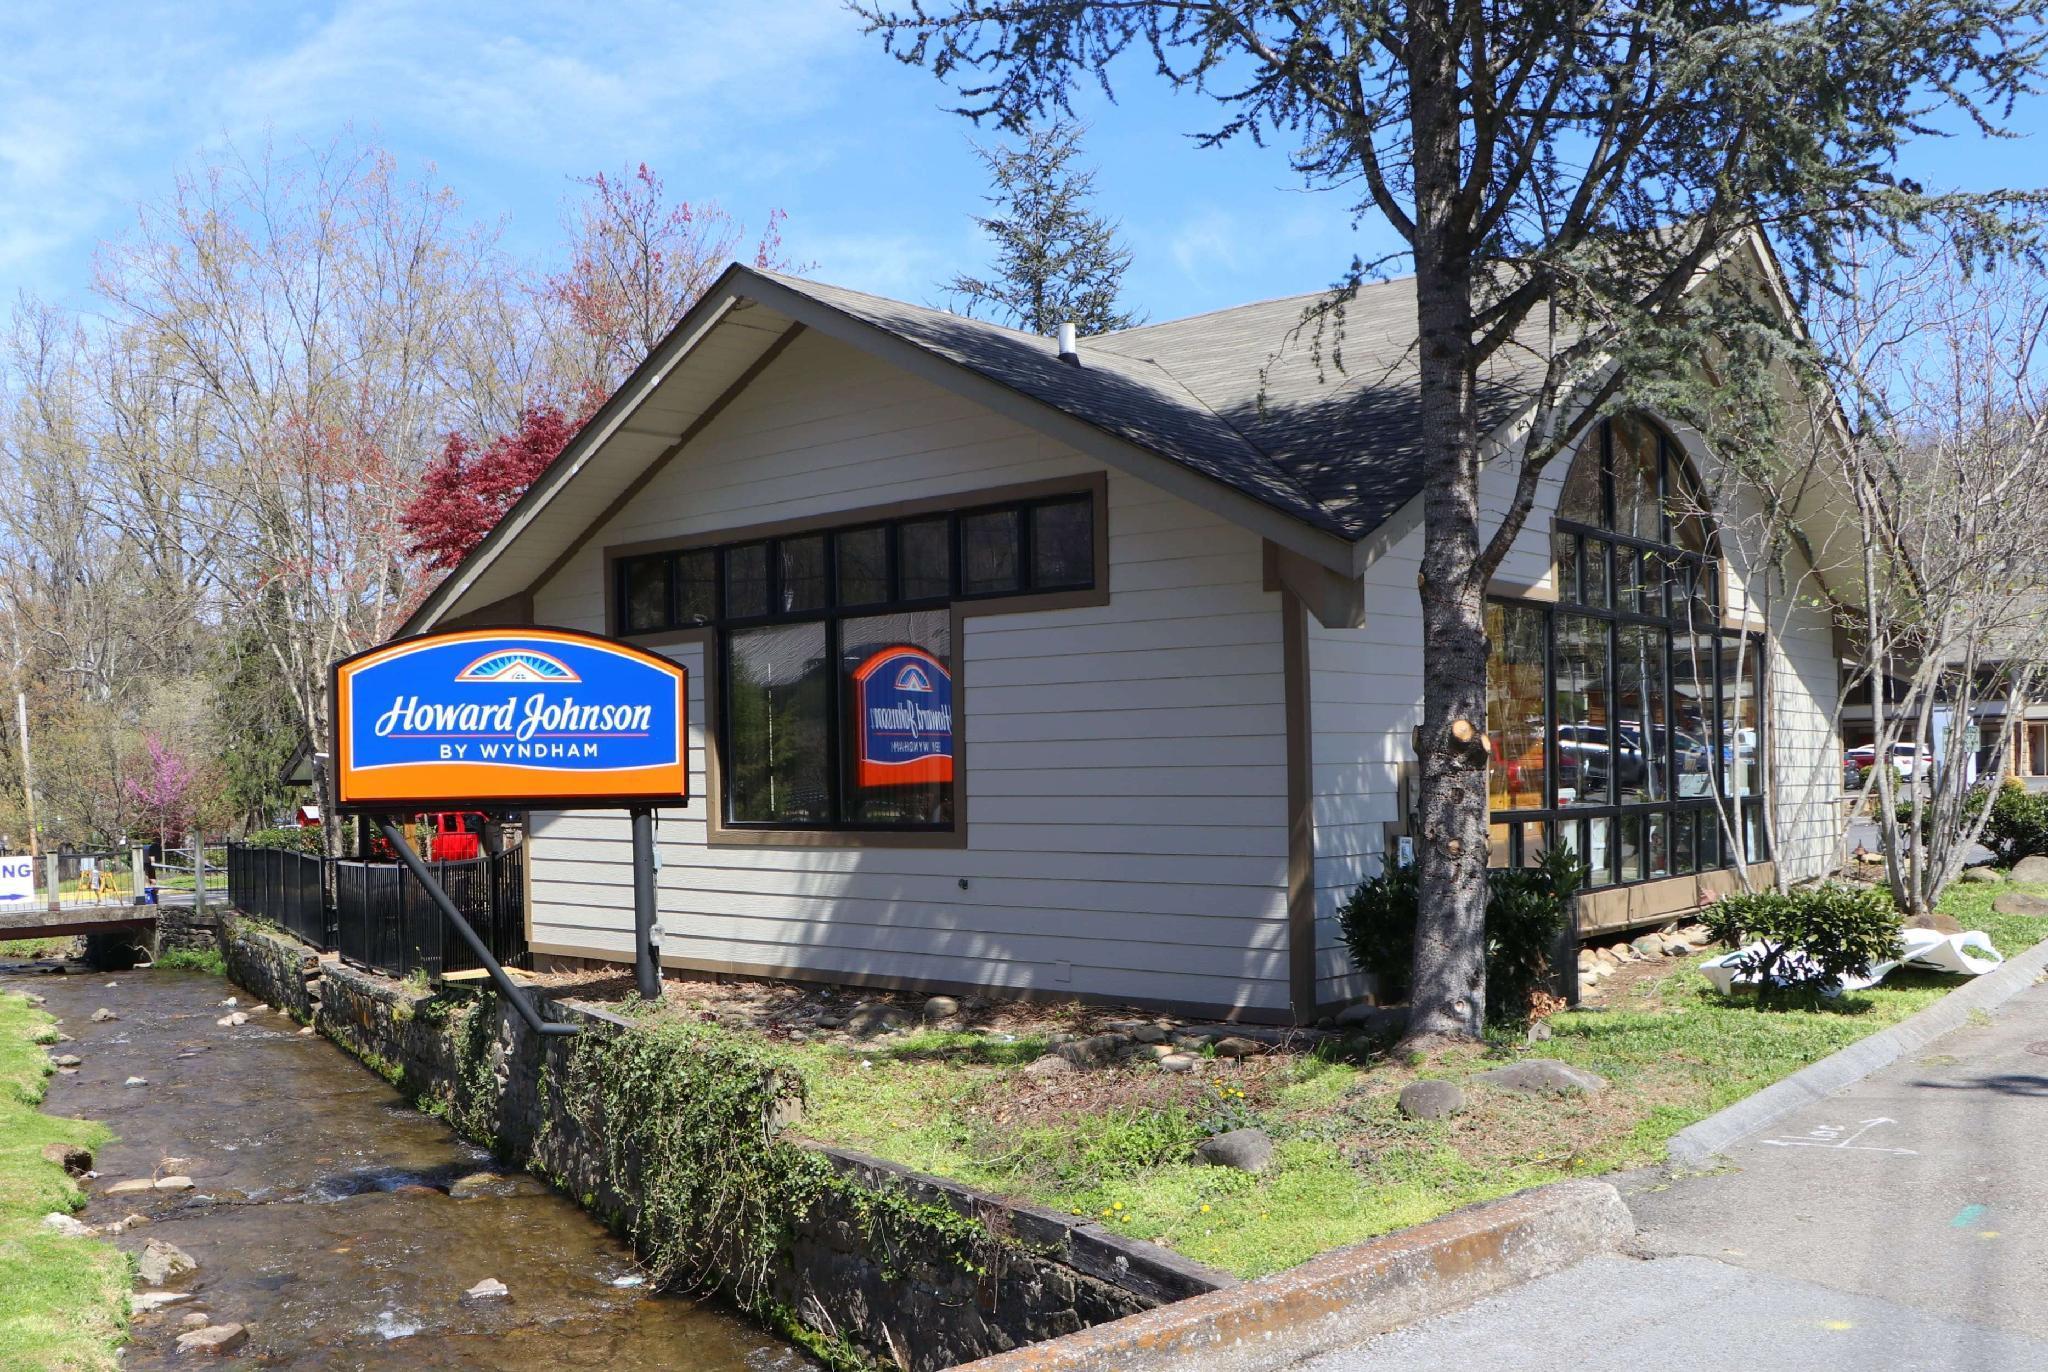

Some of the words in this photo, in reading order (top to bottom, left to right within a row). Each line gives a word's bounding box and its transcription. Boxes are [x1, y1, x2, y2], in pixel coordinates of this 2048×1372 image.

[375, 696, 516, 737] Howard
[515, 693, 652, 742] Johnson
[440, 744, 468, 759] BY
[480, 743, 598, 758] WYNDHAM
[2, 863, 31, 878] NG
